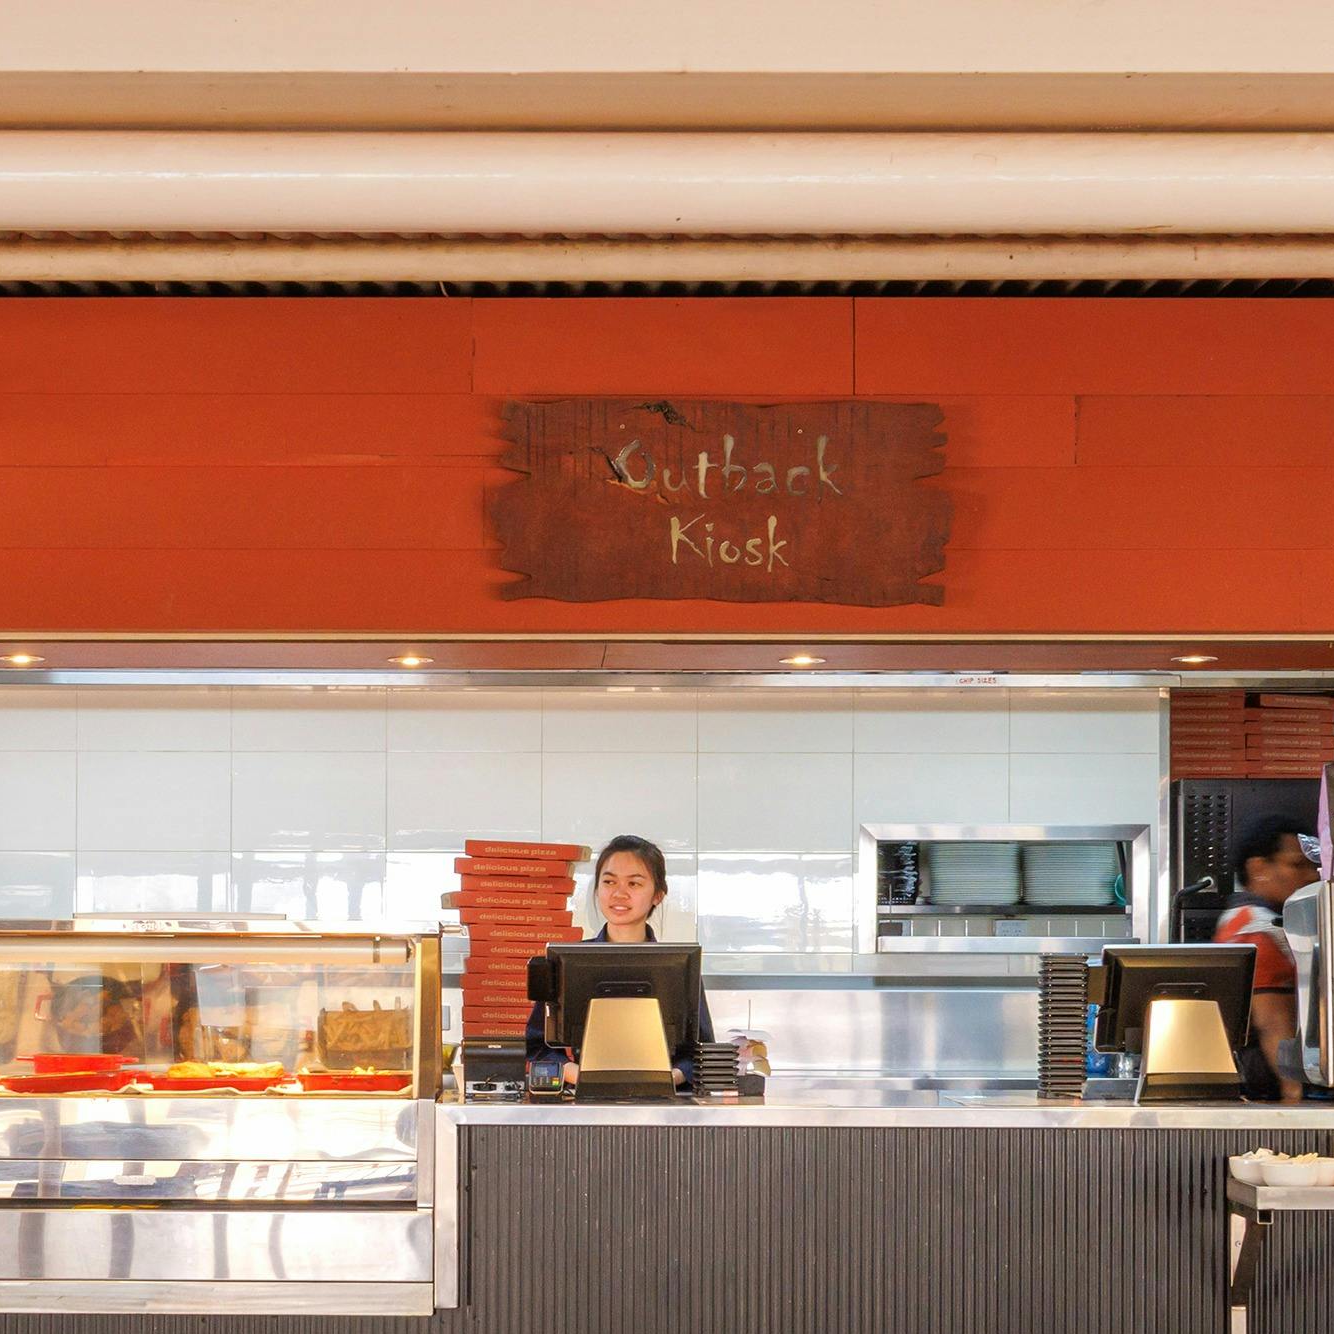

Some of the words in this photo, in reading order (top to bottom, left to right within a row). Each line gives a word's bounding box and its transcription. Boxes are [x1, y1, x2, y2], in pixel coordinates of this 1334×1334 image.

[614, 434, 843, 499] Outback
[670, 514, 789, 573] Kiosk
[484, 846, 530, 855] delicious
[473, 864, 518, 872] delicious
[476, 896, 521, 904] delicious
[479, 913, 525, 921] delicious
[490, 930, 535, 938] delicious
